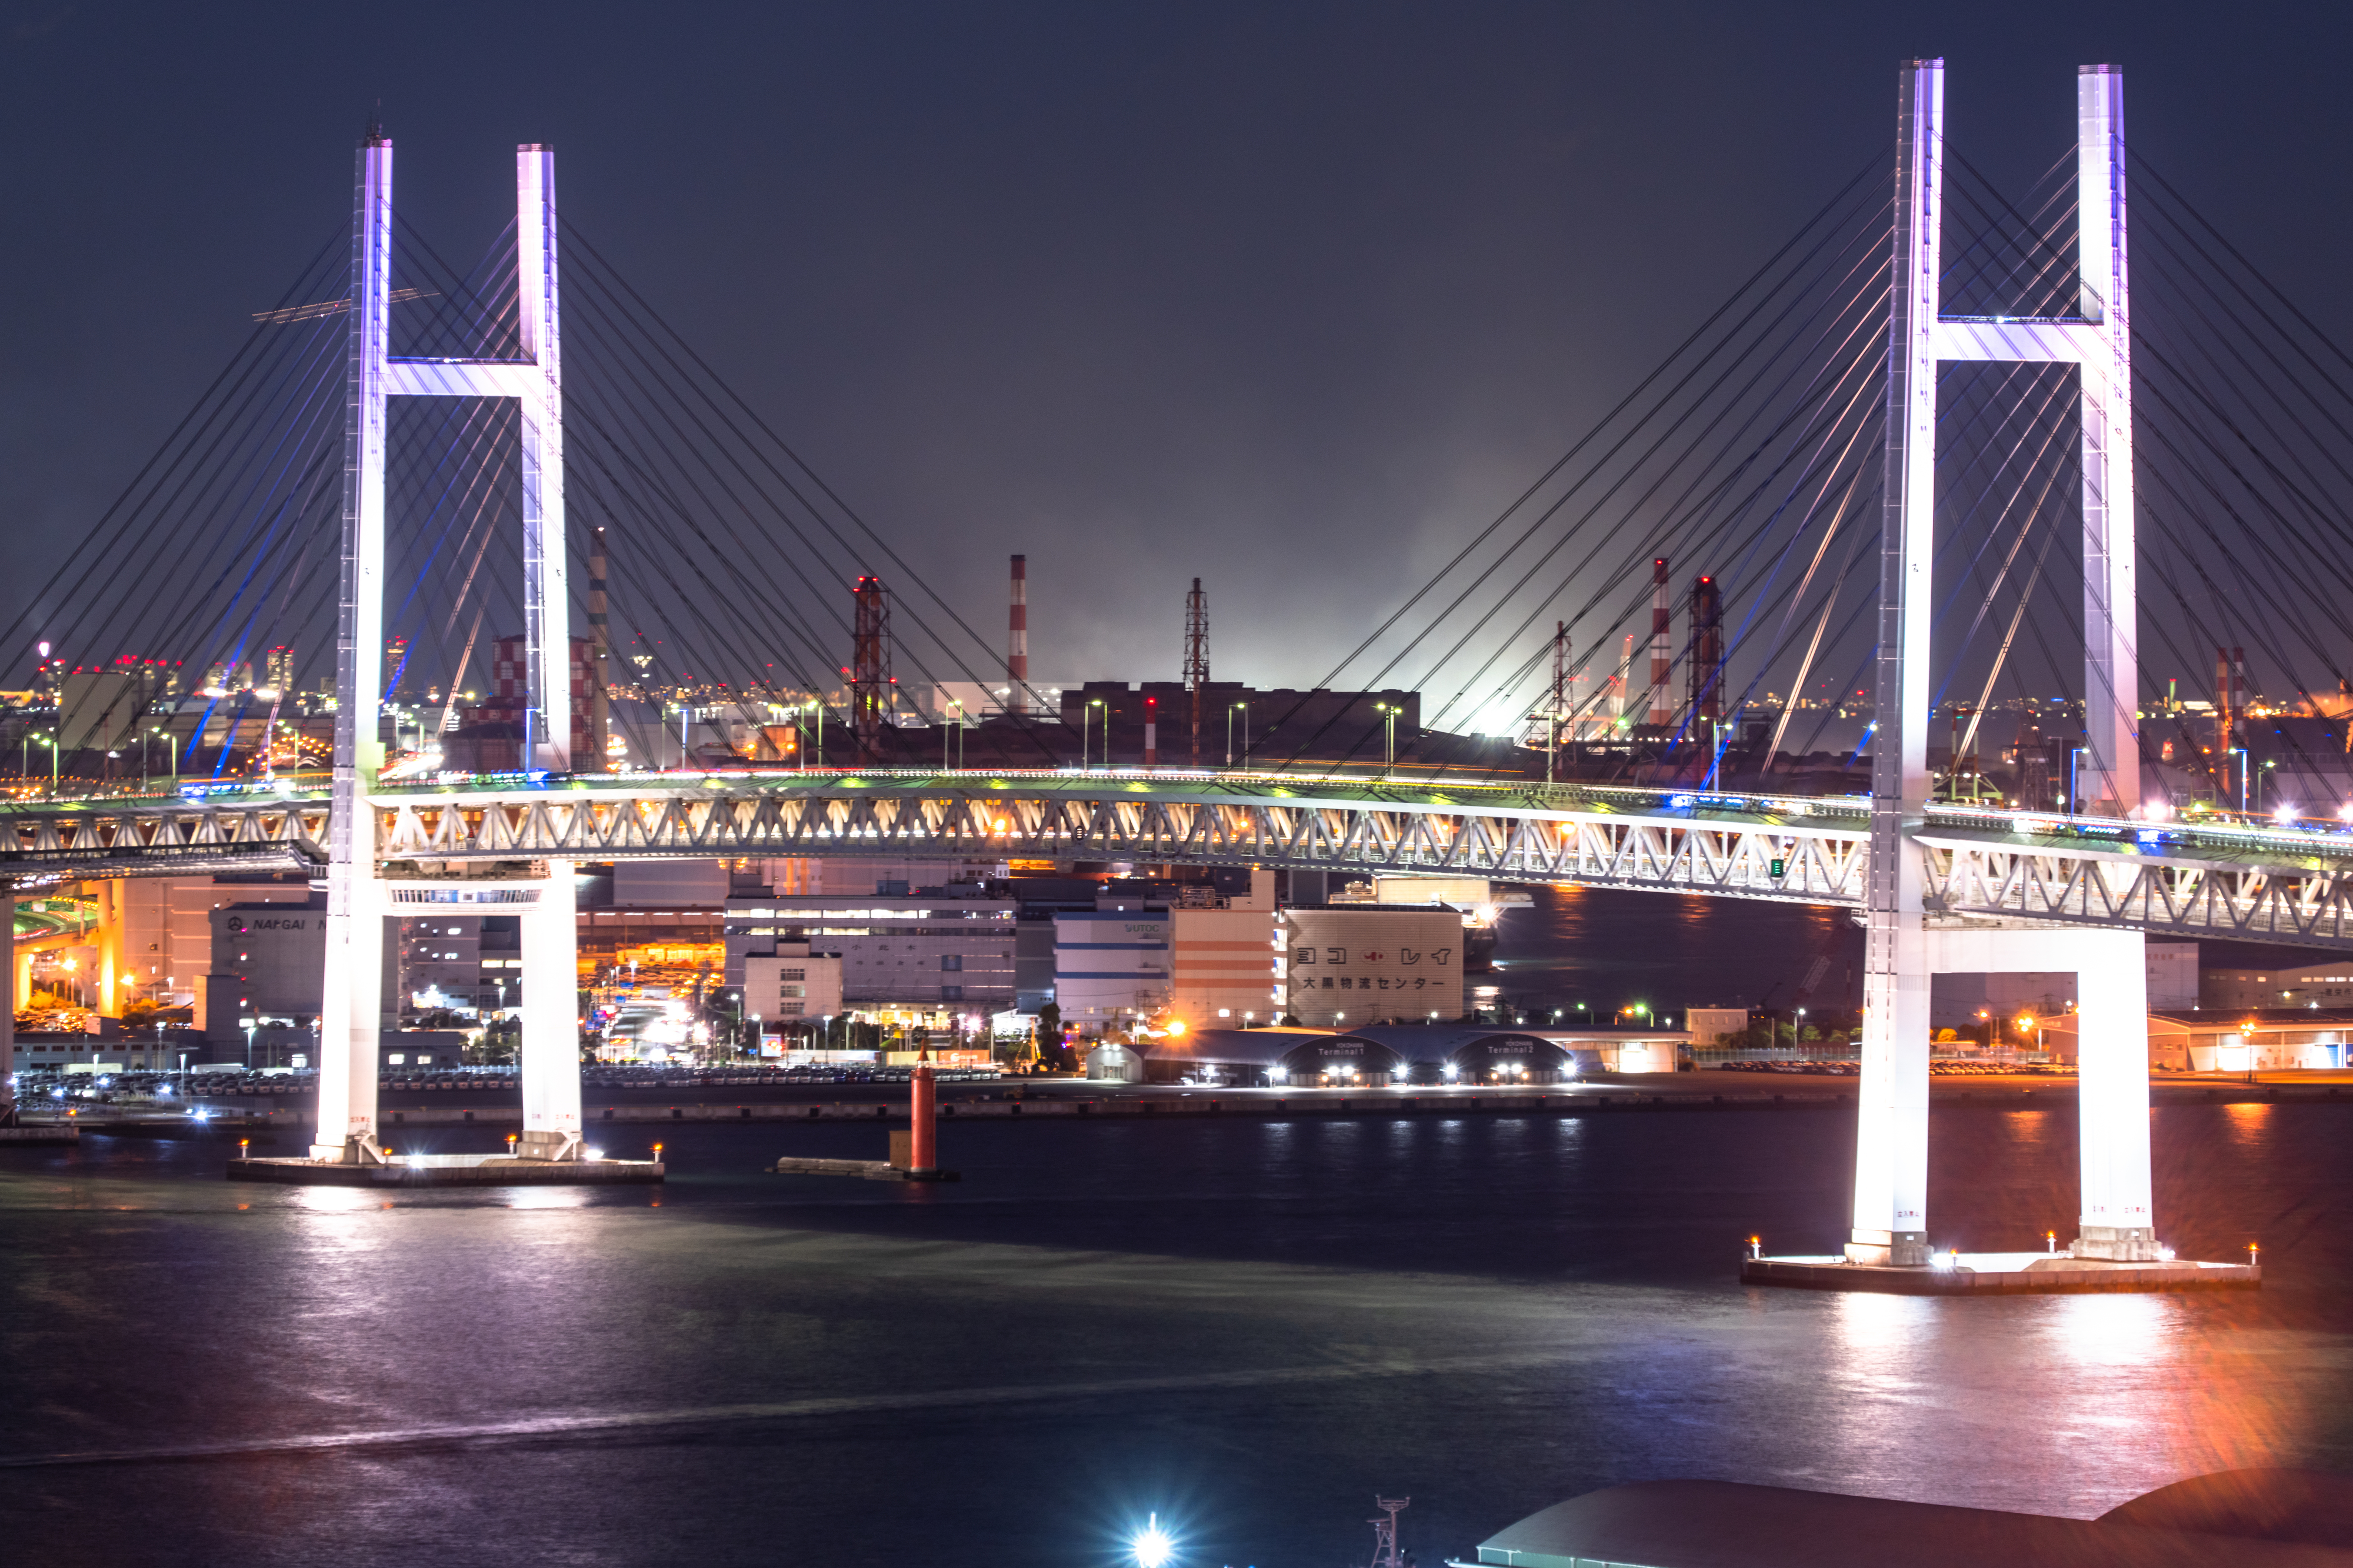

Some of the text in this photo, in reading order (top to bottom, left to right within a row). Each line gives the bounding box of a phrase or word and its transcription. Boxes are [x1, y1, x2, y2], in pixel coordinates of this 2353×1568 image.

[2164, 743, 2174, 752] K
[1303, 977, 1444, 989] 大黒物流センター
